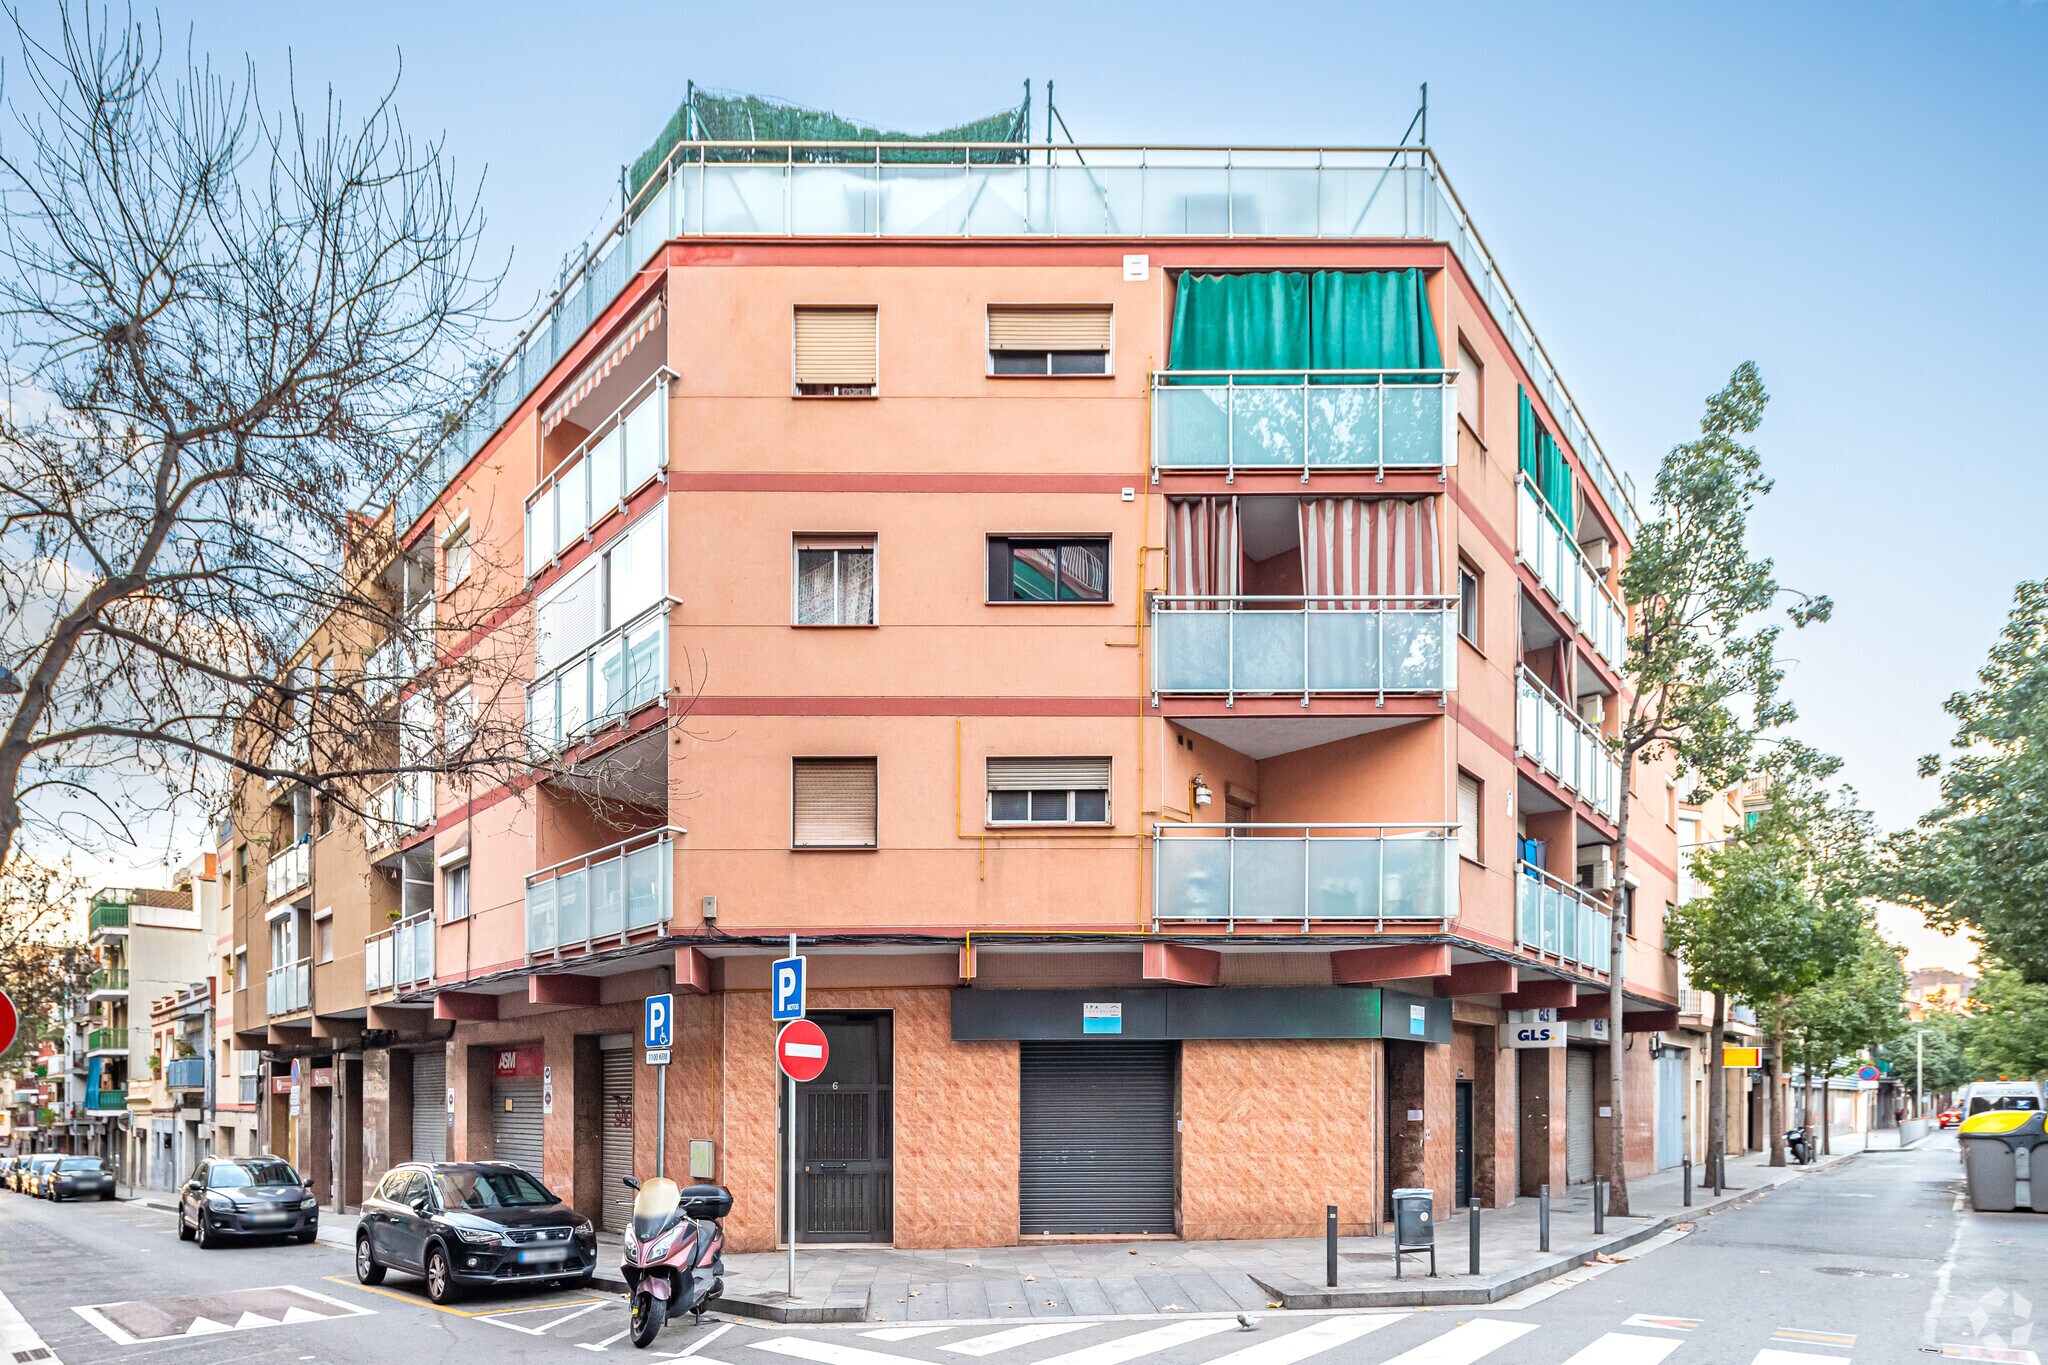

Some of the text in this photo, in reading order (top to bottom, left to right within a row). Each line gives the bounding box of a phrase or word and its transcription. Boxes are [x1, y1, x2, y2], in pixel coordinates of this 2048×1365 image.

[778, 967, 796, 1012] P
[650, 1002, 665, 1041] P
[498, 1051, 516, 1069] ASM
[832, 1081, 839, 1090] 6
